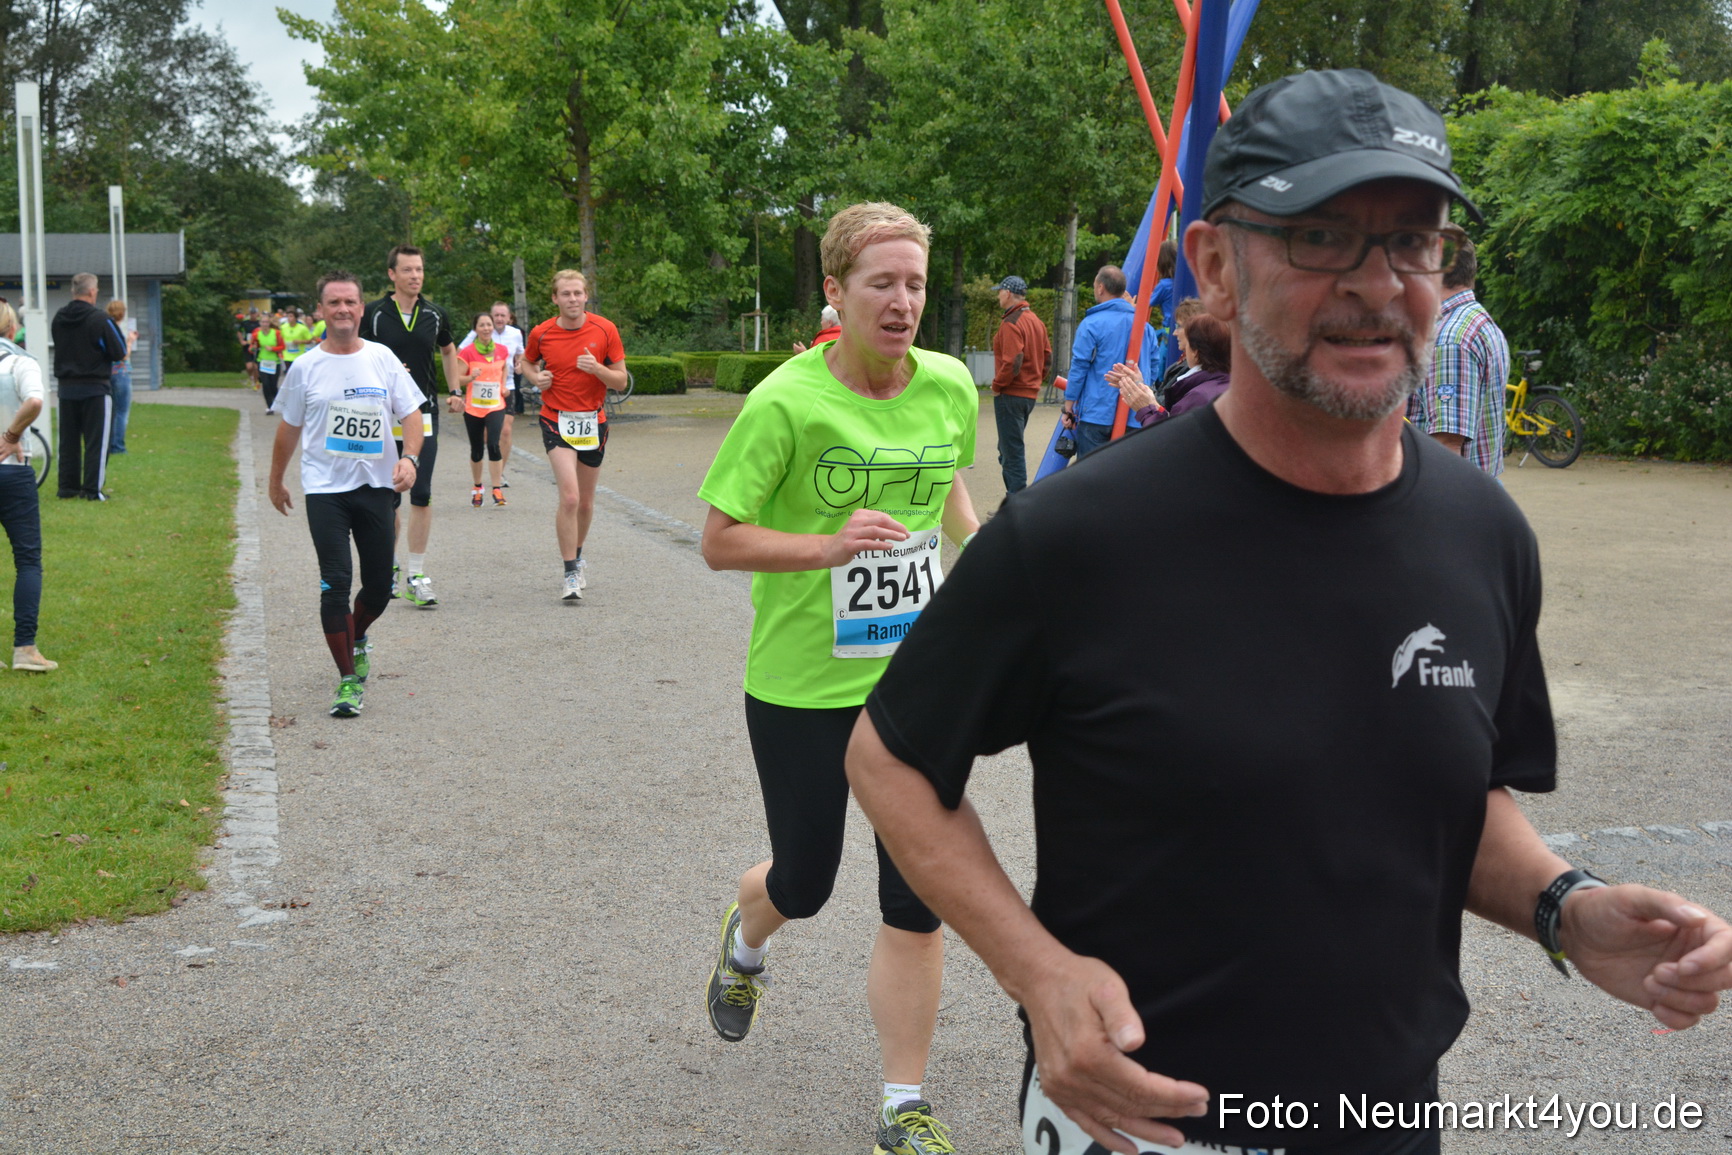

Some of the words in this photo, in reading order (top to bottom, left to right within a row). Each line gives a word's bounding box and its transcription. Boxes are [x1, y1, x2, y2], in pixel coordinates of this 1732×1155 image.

[1392, 126, 1446, 157] 2XU
[480, 388, 493, 398] 26
[333, 415, 381, 438] 2652
[567, 420, 592, 435] 318
[347, 442, 364, 451] Udo
[883, 541, 927, 558] Neumarkt
[847, 556, 936, 612] 2541
[867, 621, 915, 641] Ramo
[1418, 657, 1476, 688] Frank
